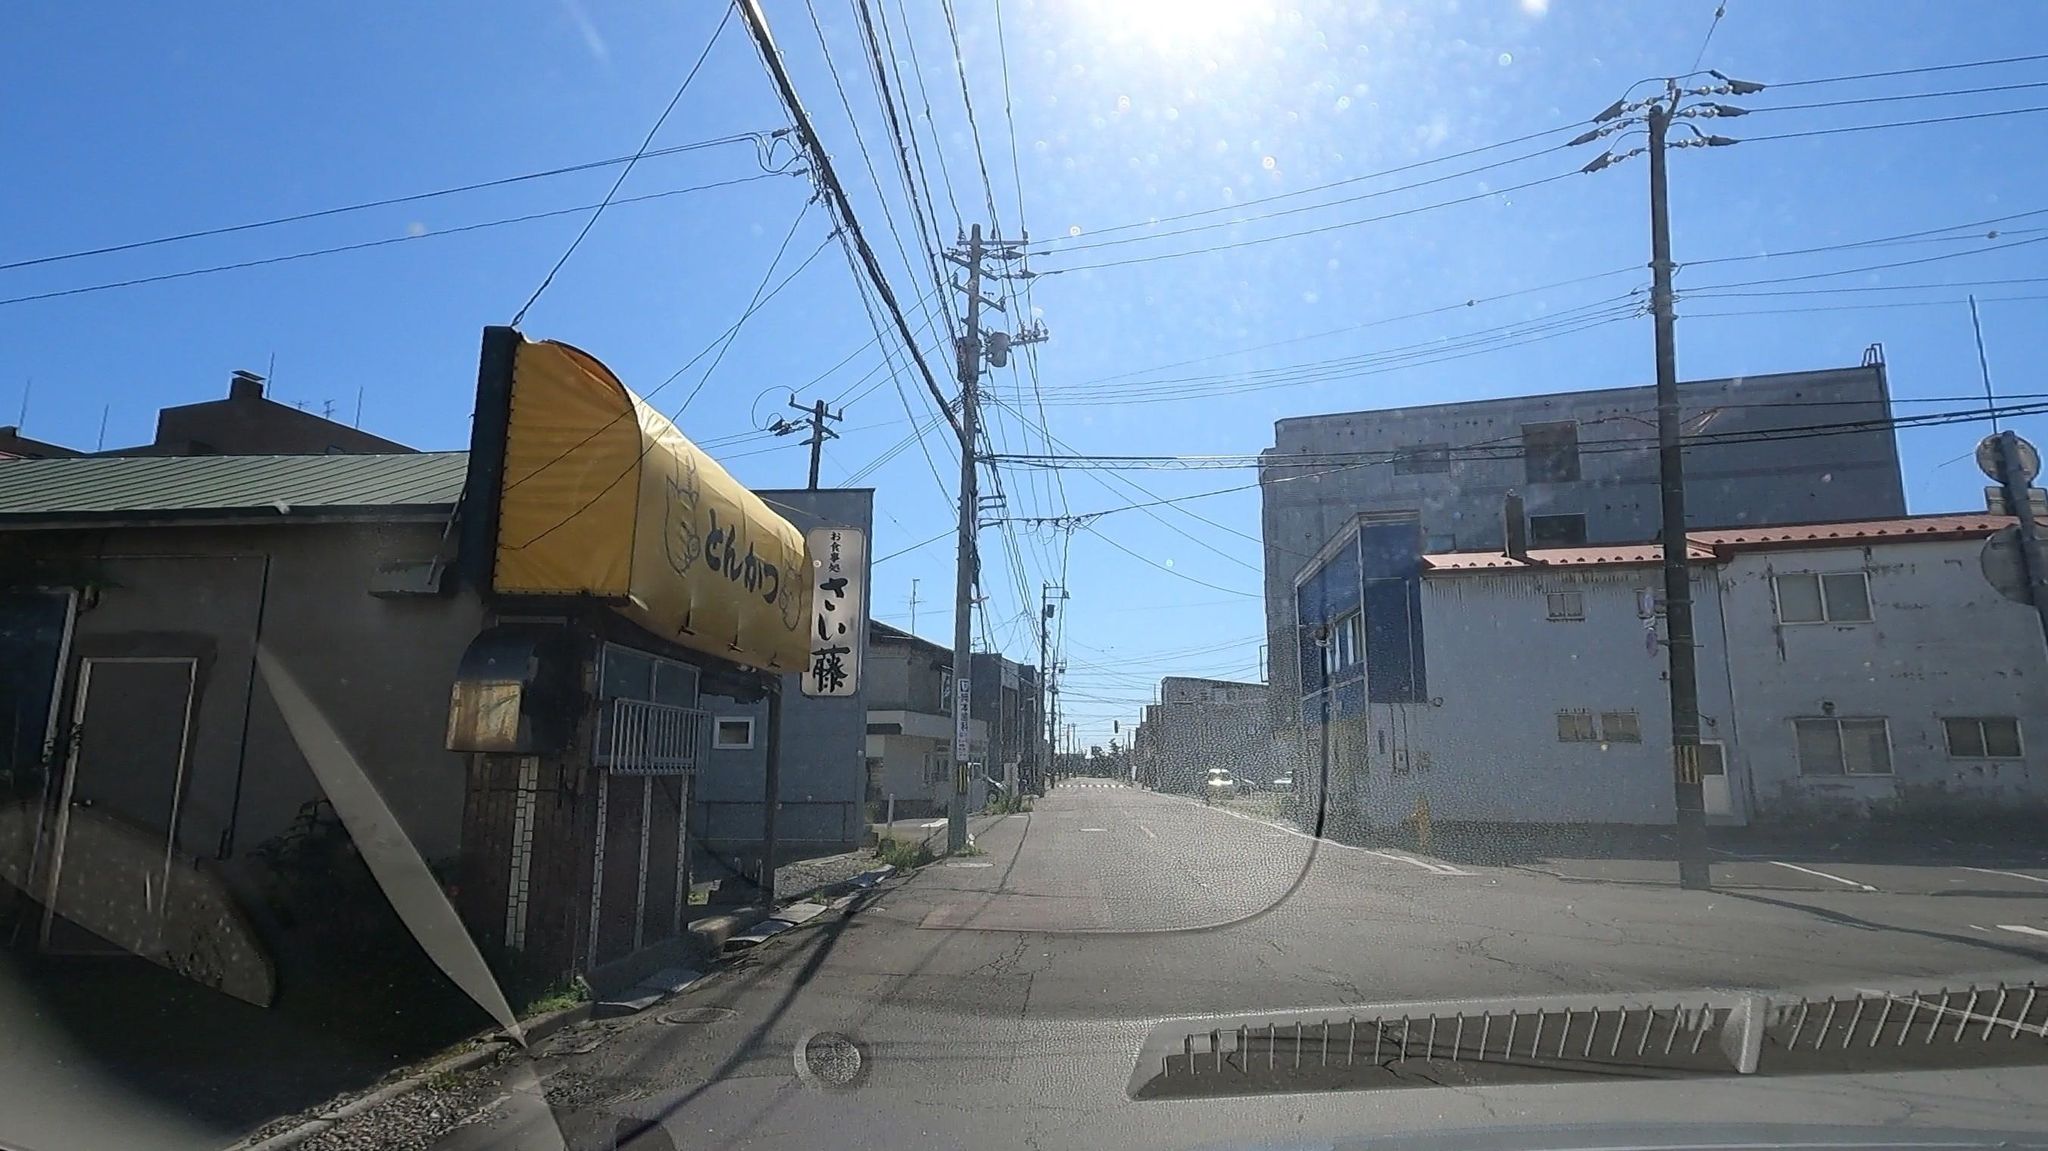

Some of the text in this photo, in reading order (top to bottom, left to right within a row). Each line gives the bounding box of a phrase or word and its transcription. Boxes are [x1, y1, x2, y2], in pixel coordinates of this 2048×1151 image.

[706, 509, 778, 604] とんかつ
[828, 531, 841, 573] お食事処
[812, 578, 850, 693] さい藤
